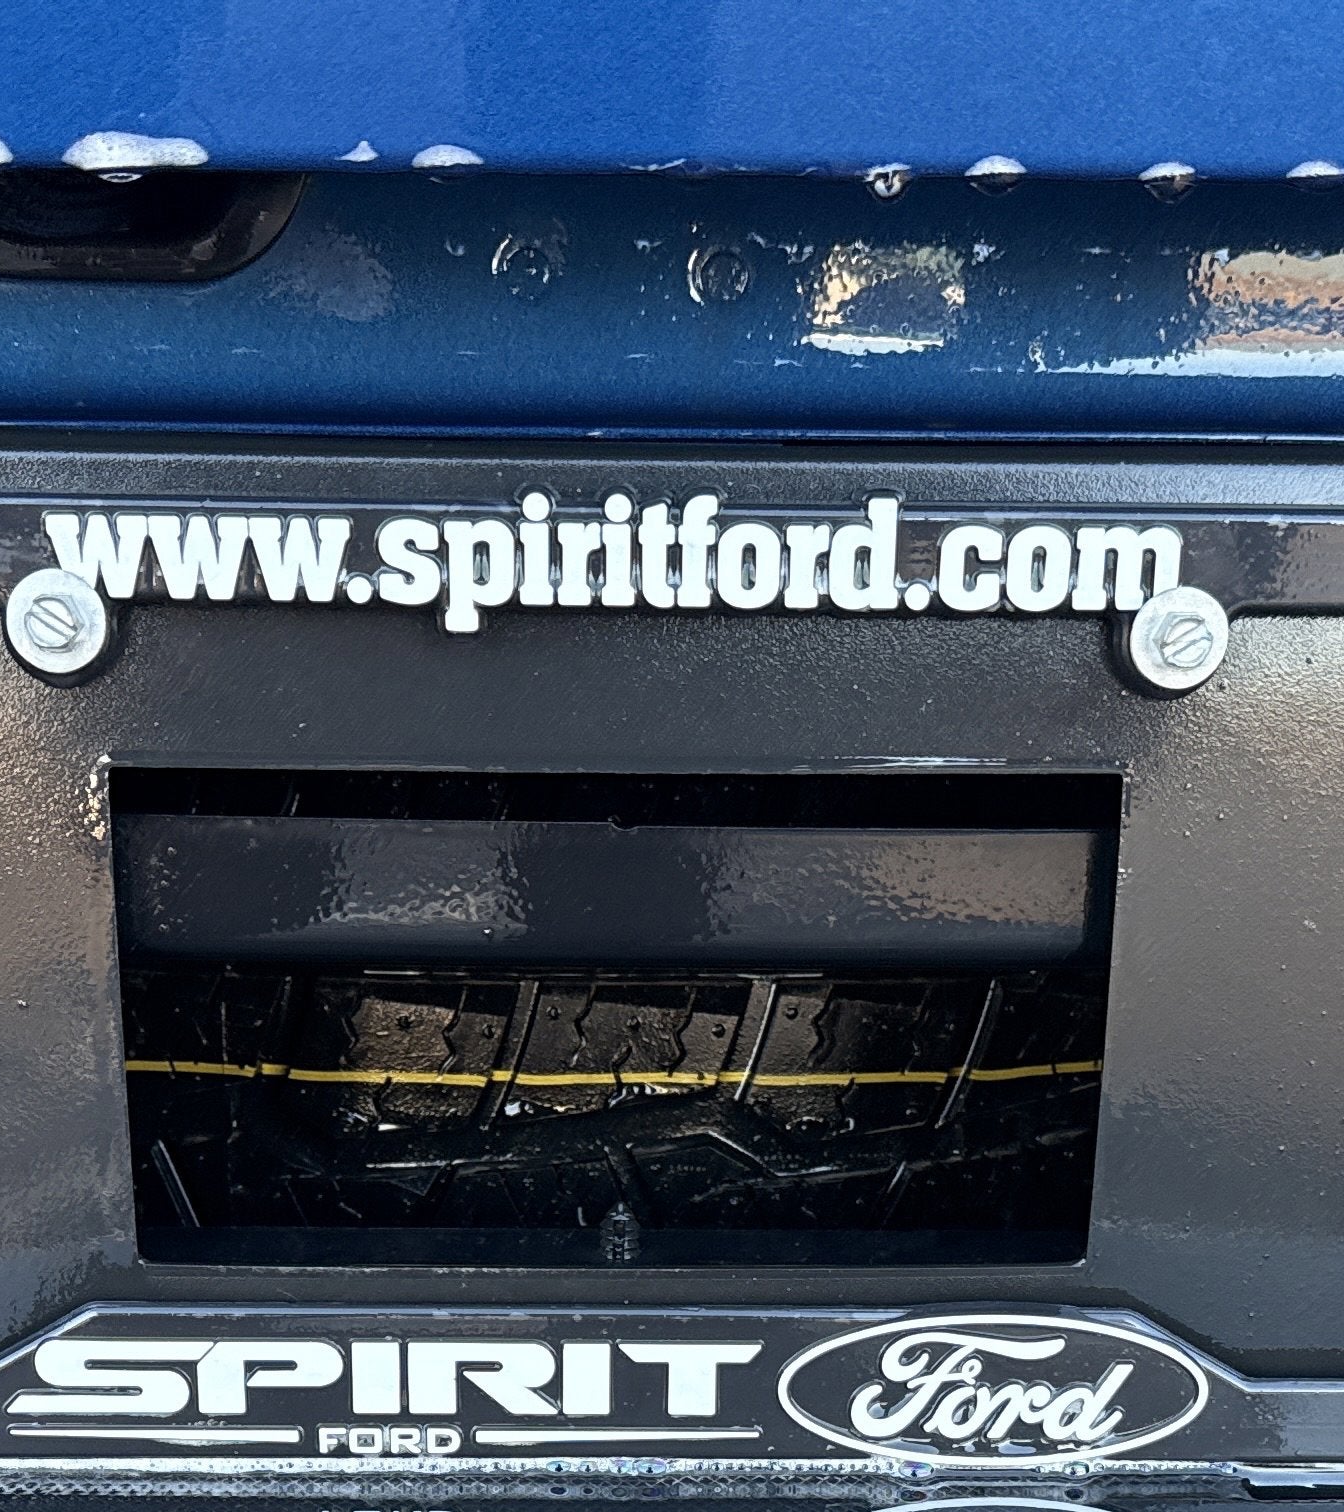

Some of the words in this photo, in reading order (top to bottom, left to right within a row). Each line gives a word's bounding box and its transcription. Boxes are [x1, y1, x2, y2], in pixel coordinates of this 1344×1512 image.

[43, 492, 1183, 633] www.spiritford.com
[6, 1337, 763, 1417] SPIRIT
[850, 1330, 1135, 1442] Ford
[317, 1426, 462, 1456] FORD
